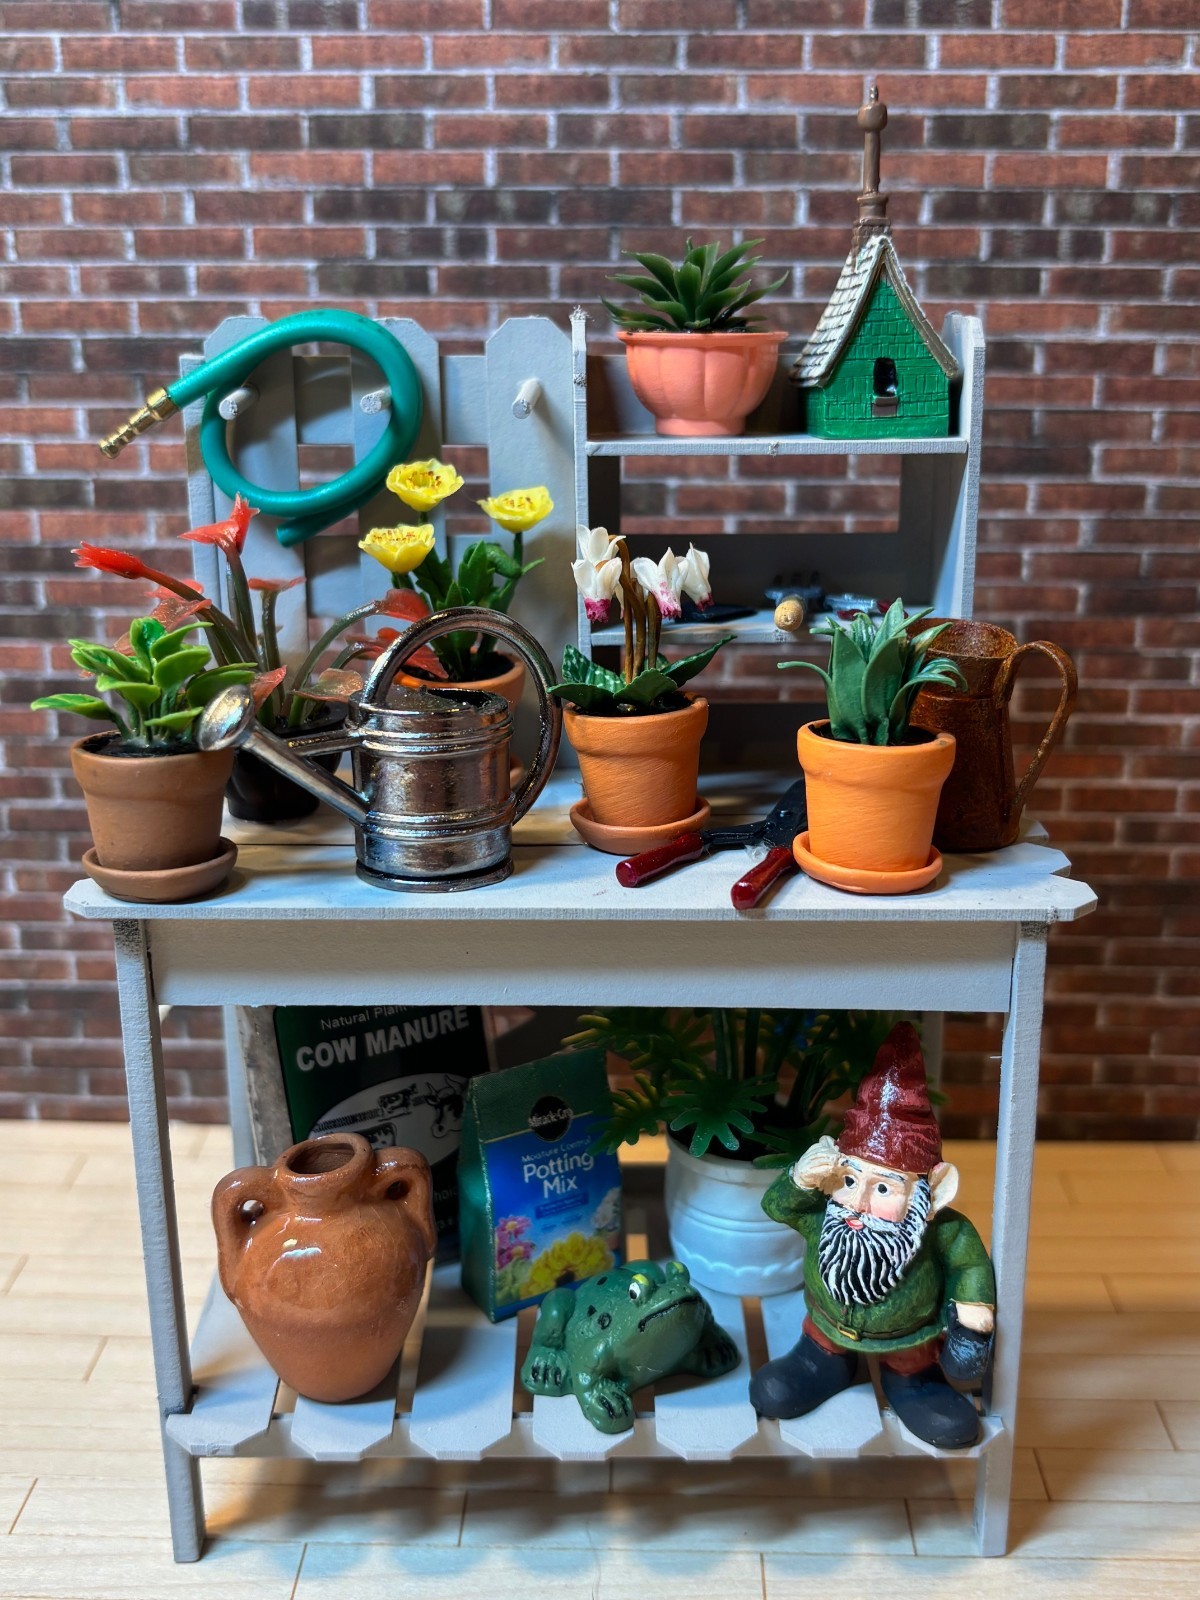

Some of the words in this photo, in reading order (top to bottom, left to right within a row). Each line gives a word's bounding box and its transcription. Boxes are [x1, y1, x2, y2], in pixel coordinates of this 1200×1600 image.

[320, 1009, 370, 1031] Natural
[296, 1035, 357, 1072] COW
[364, 1007, 470, 1058] MANURE
[523, 1153, 595, 1184] Potting
[542, 1175, 578, 1199] Mix
